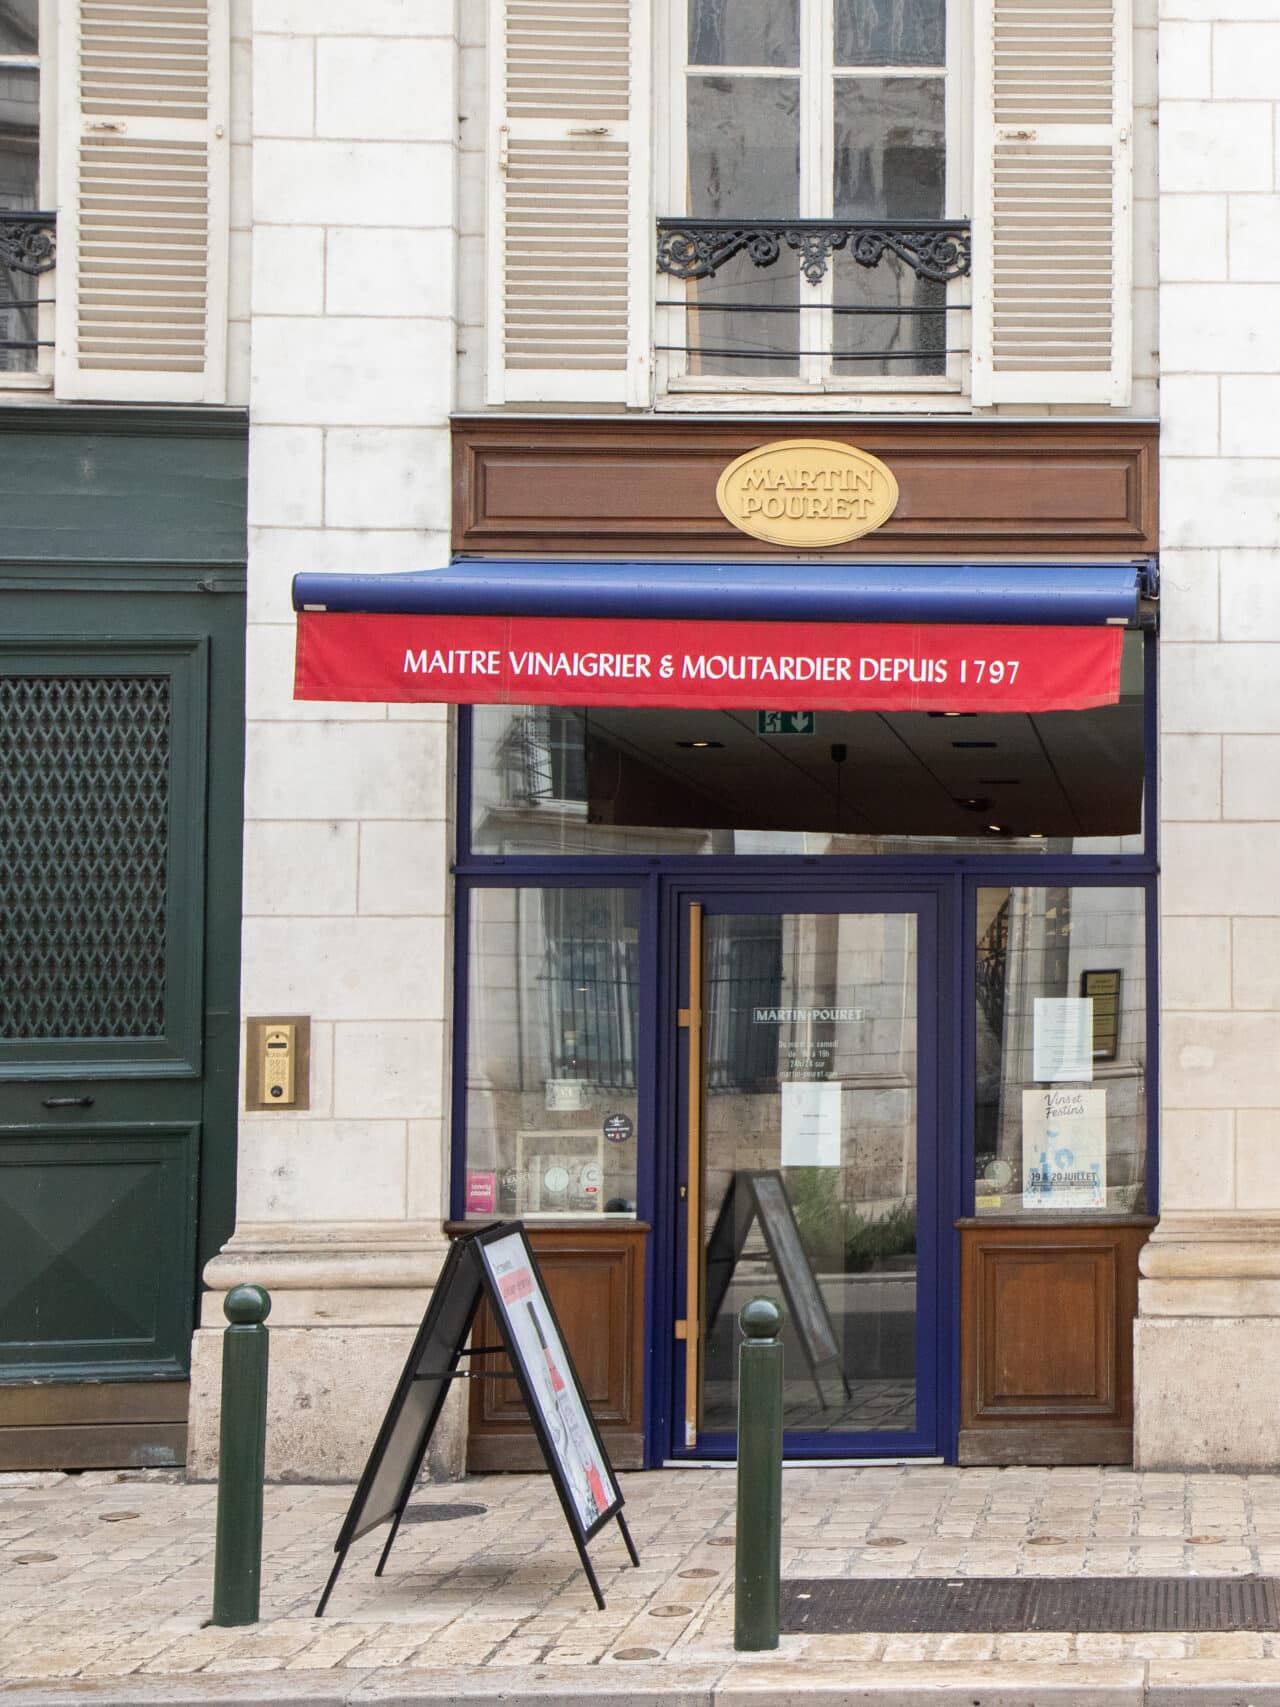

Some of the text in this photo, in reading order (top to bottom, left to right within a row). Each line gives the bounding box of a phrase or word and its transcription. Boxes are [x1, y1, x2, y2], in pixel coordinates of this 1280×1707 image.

[741, 468, 875, 491] MARTIN
[741, 496, 875, 520] POURET
[402, 649, 1021, 685] MAITRE VINAIGRIER & MOUTARDIER DEPUIS 1797
[756, 1009, 861, 1021] MARTIN POURET
[1031, 1172, 1041, 1181] 19
[1051, 1172, 1063, 1181] 20
[1064, 1172, 1097, 1181] JUILLET
